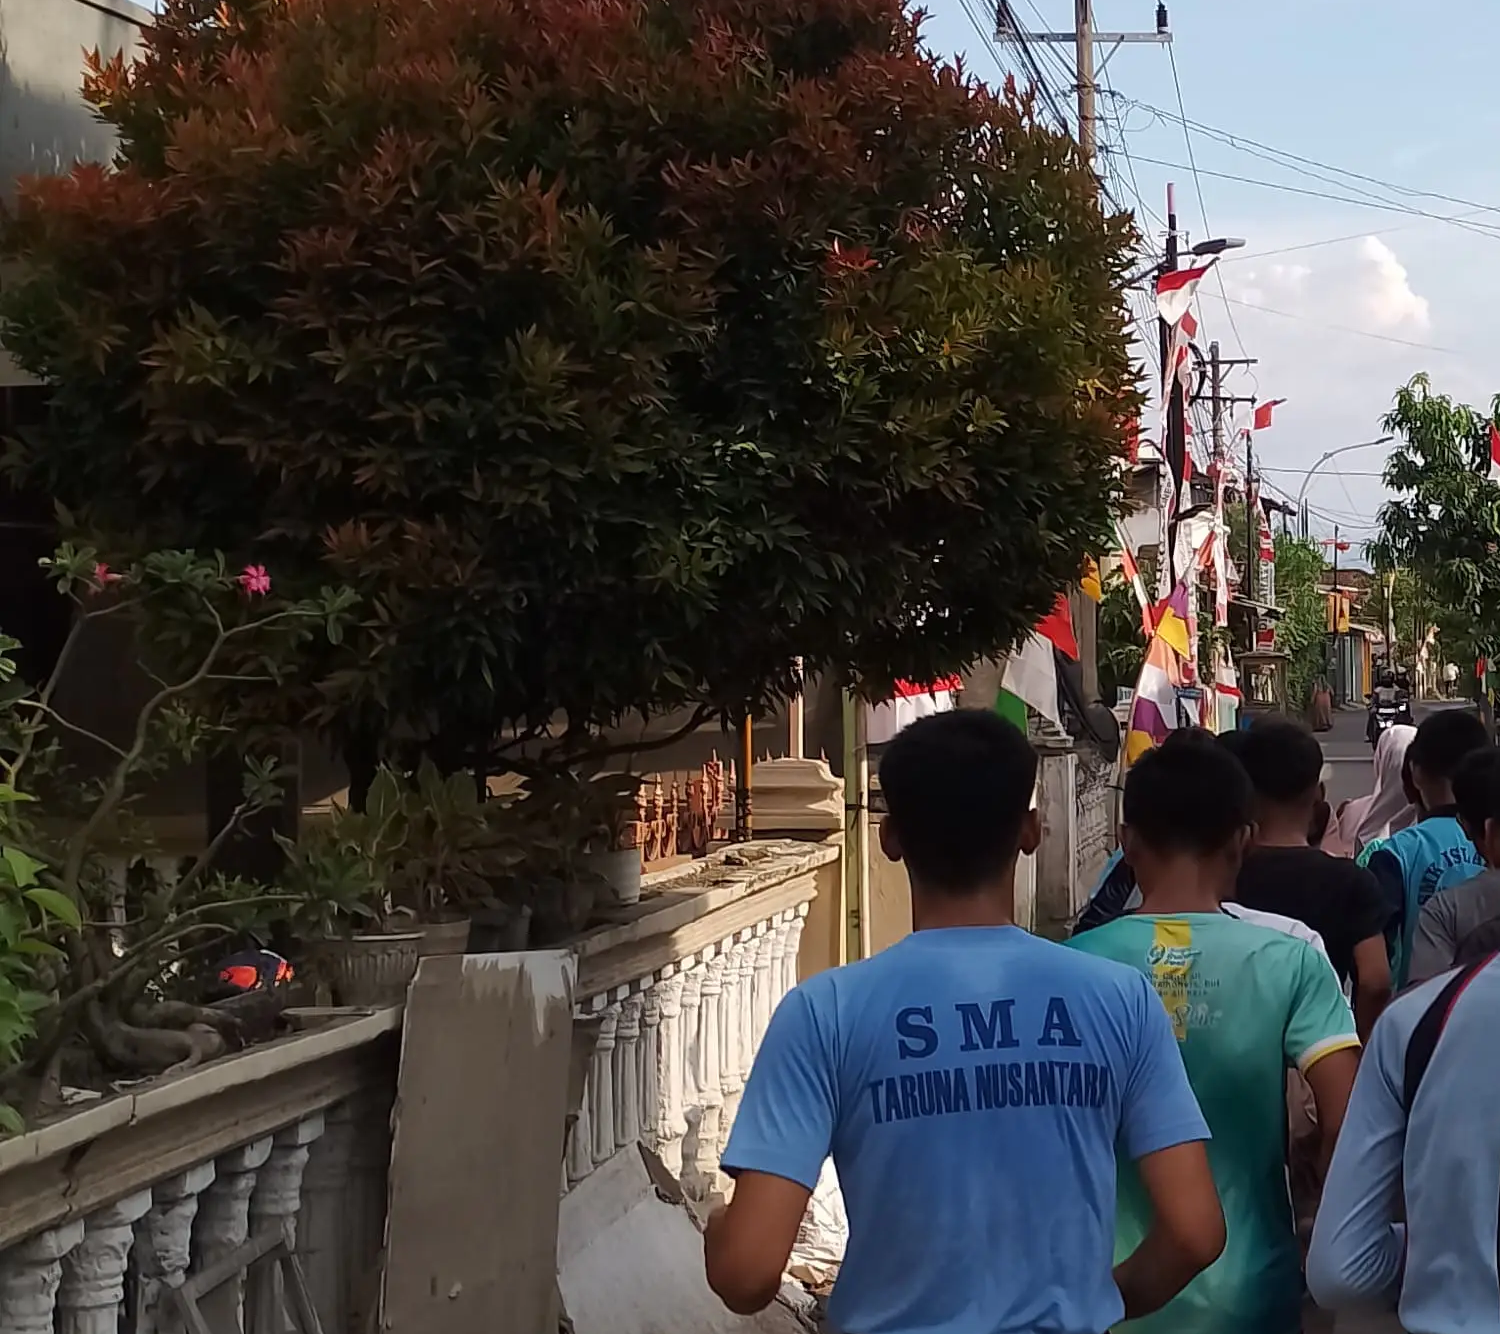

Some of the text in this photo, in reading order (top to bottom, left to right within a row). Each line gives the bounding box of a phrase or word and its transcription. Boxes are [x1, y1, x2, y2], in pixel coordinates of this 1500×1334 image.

[1418, 846, 1483, 905] SMK ISLA
[868, 1068, 972, 1125] TARUNA
